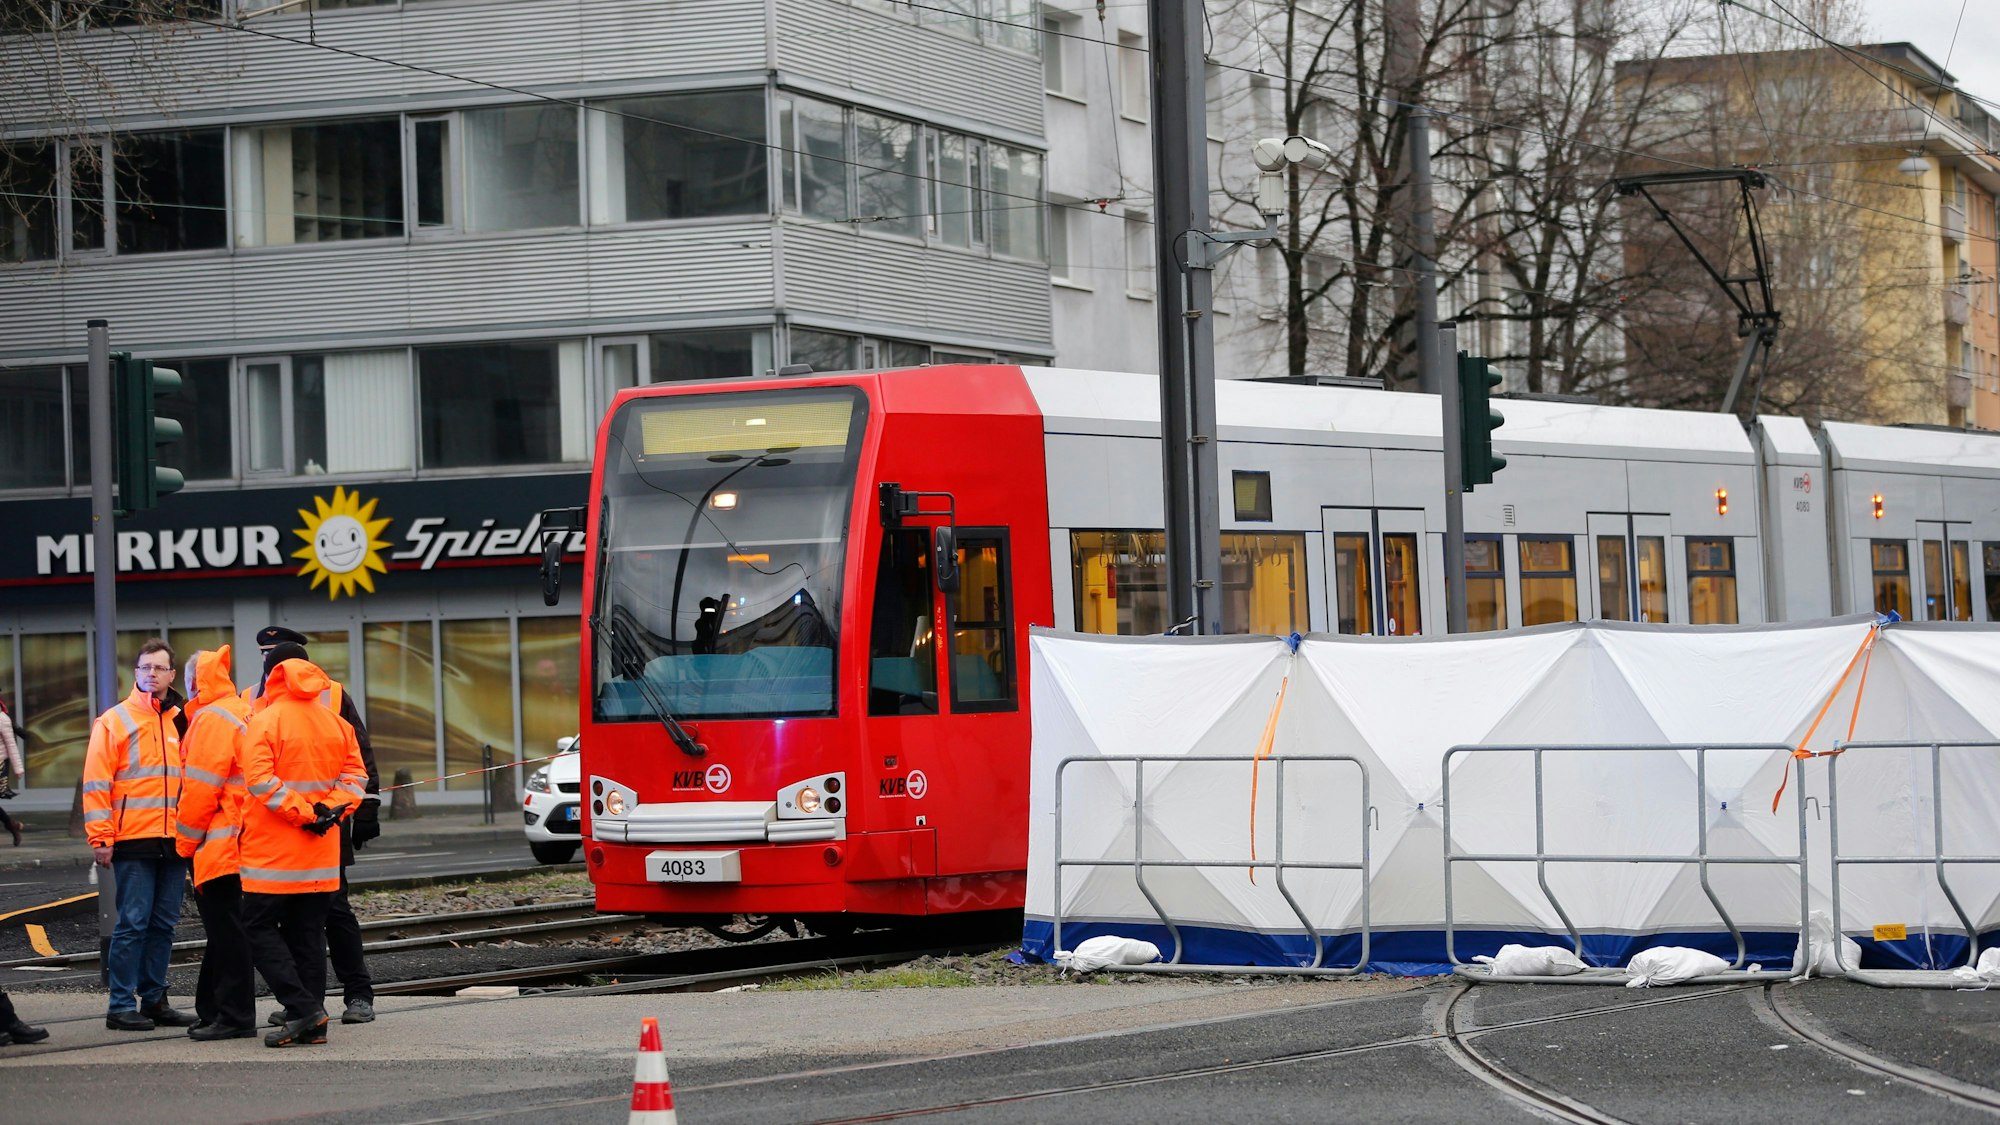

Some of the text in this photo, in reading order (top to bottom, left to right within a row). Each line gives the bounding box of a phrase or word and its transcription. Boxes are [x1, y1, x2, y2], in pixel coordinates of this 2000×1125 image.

[673, 771, 705, 787] KVB
[880, 777, 906, 795] KVB
[661, 860, 705, 876] 4083
